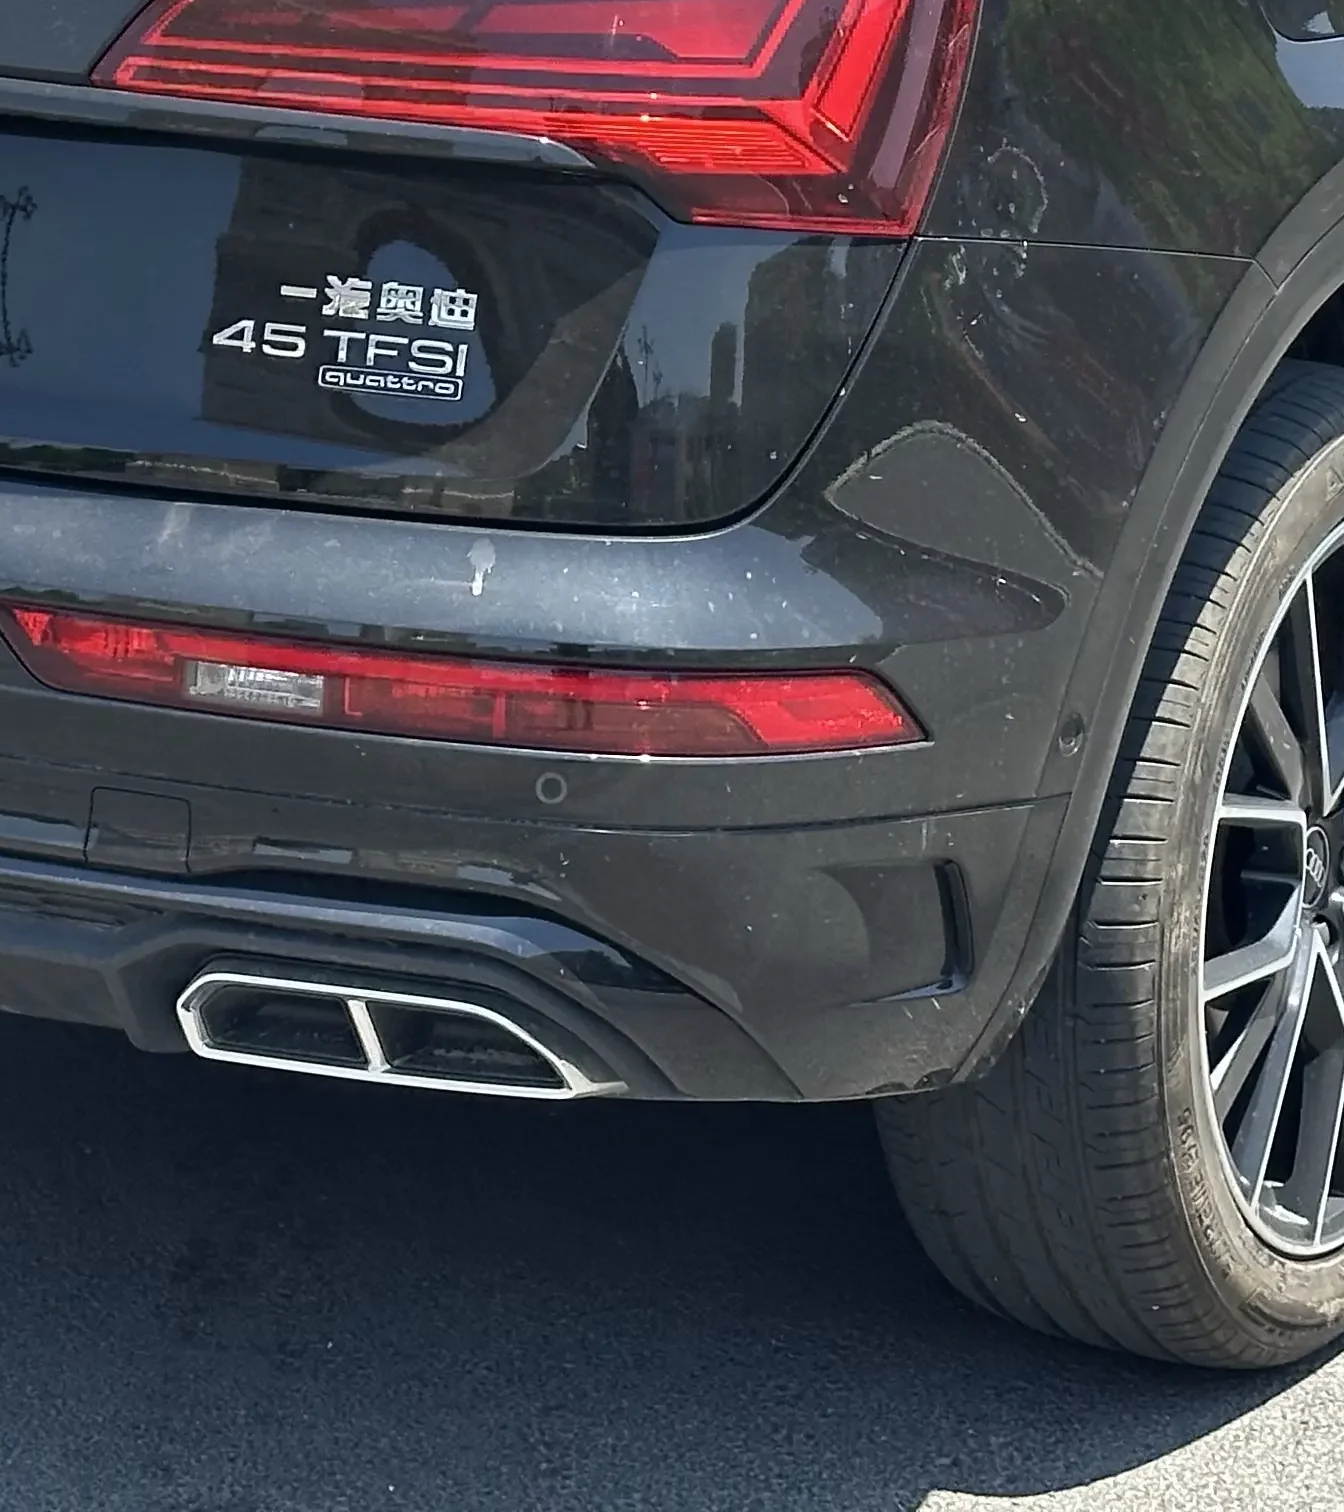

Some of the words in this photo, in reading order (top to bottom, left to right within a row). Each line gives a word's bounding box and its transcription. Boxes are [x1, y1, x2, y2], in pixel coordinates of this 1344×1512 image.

[280, 274, 478, 331] 一汽奥迪
[212, 319, 307, 358] 45
[322, 328, 469, 377] TFSI
[324, 370, 456, 395] quattro
